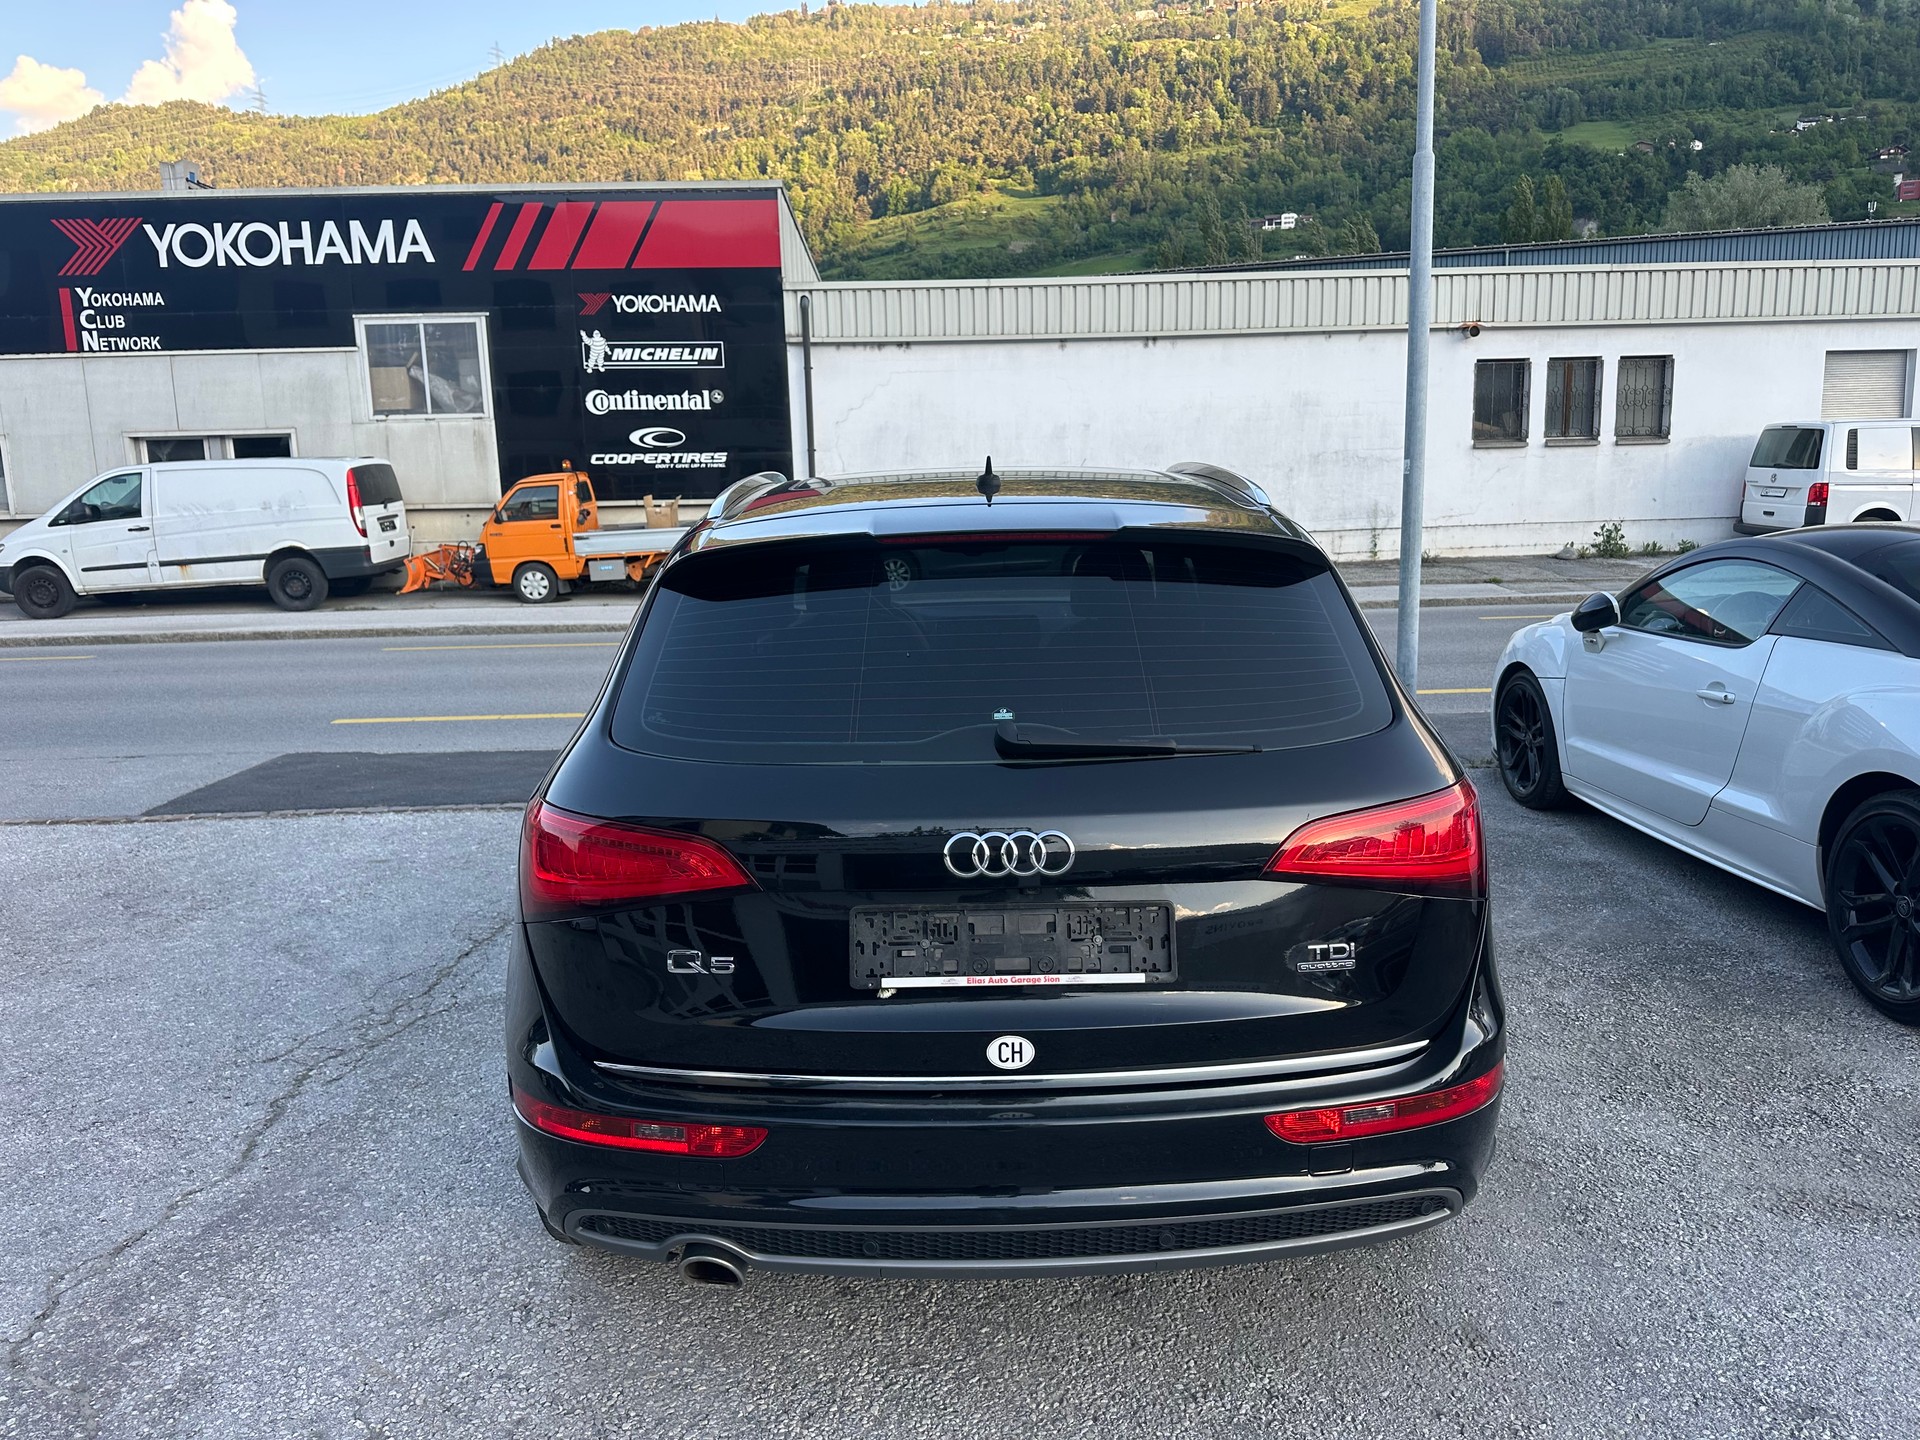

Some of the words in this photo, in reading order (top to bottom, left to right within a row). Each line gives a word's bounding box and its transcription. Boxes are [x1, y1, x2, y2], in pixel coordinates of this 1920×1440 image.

[143, 219, 435, 268] YOKOHAMA
[75, 287, 165, 307] YOKOHAMA
[611, 294, 722, 313] YOKOHAMA
[80, 309, 126, 329] CLUB
[81, 330, 162, 351] NETWORK
[611, 347, 719, 361] MICHELIN
[585, 389, 712, 415] Continental
[1307, 942, 1356, 960] TDI
[667, 949, 735, 975] Q5
[1299, 960, 1355, 972] quattro
[966, 976, 986, 985] Elias
[988, 976, 1008, 984] Auto
[1010, 976, 1042, 985] Garage
[1044, 975, 1060, 983] Sion
[997, 1041, 1023, 1063] CH
